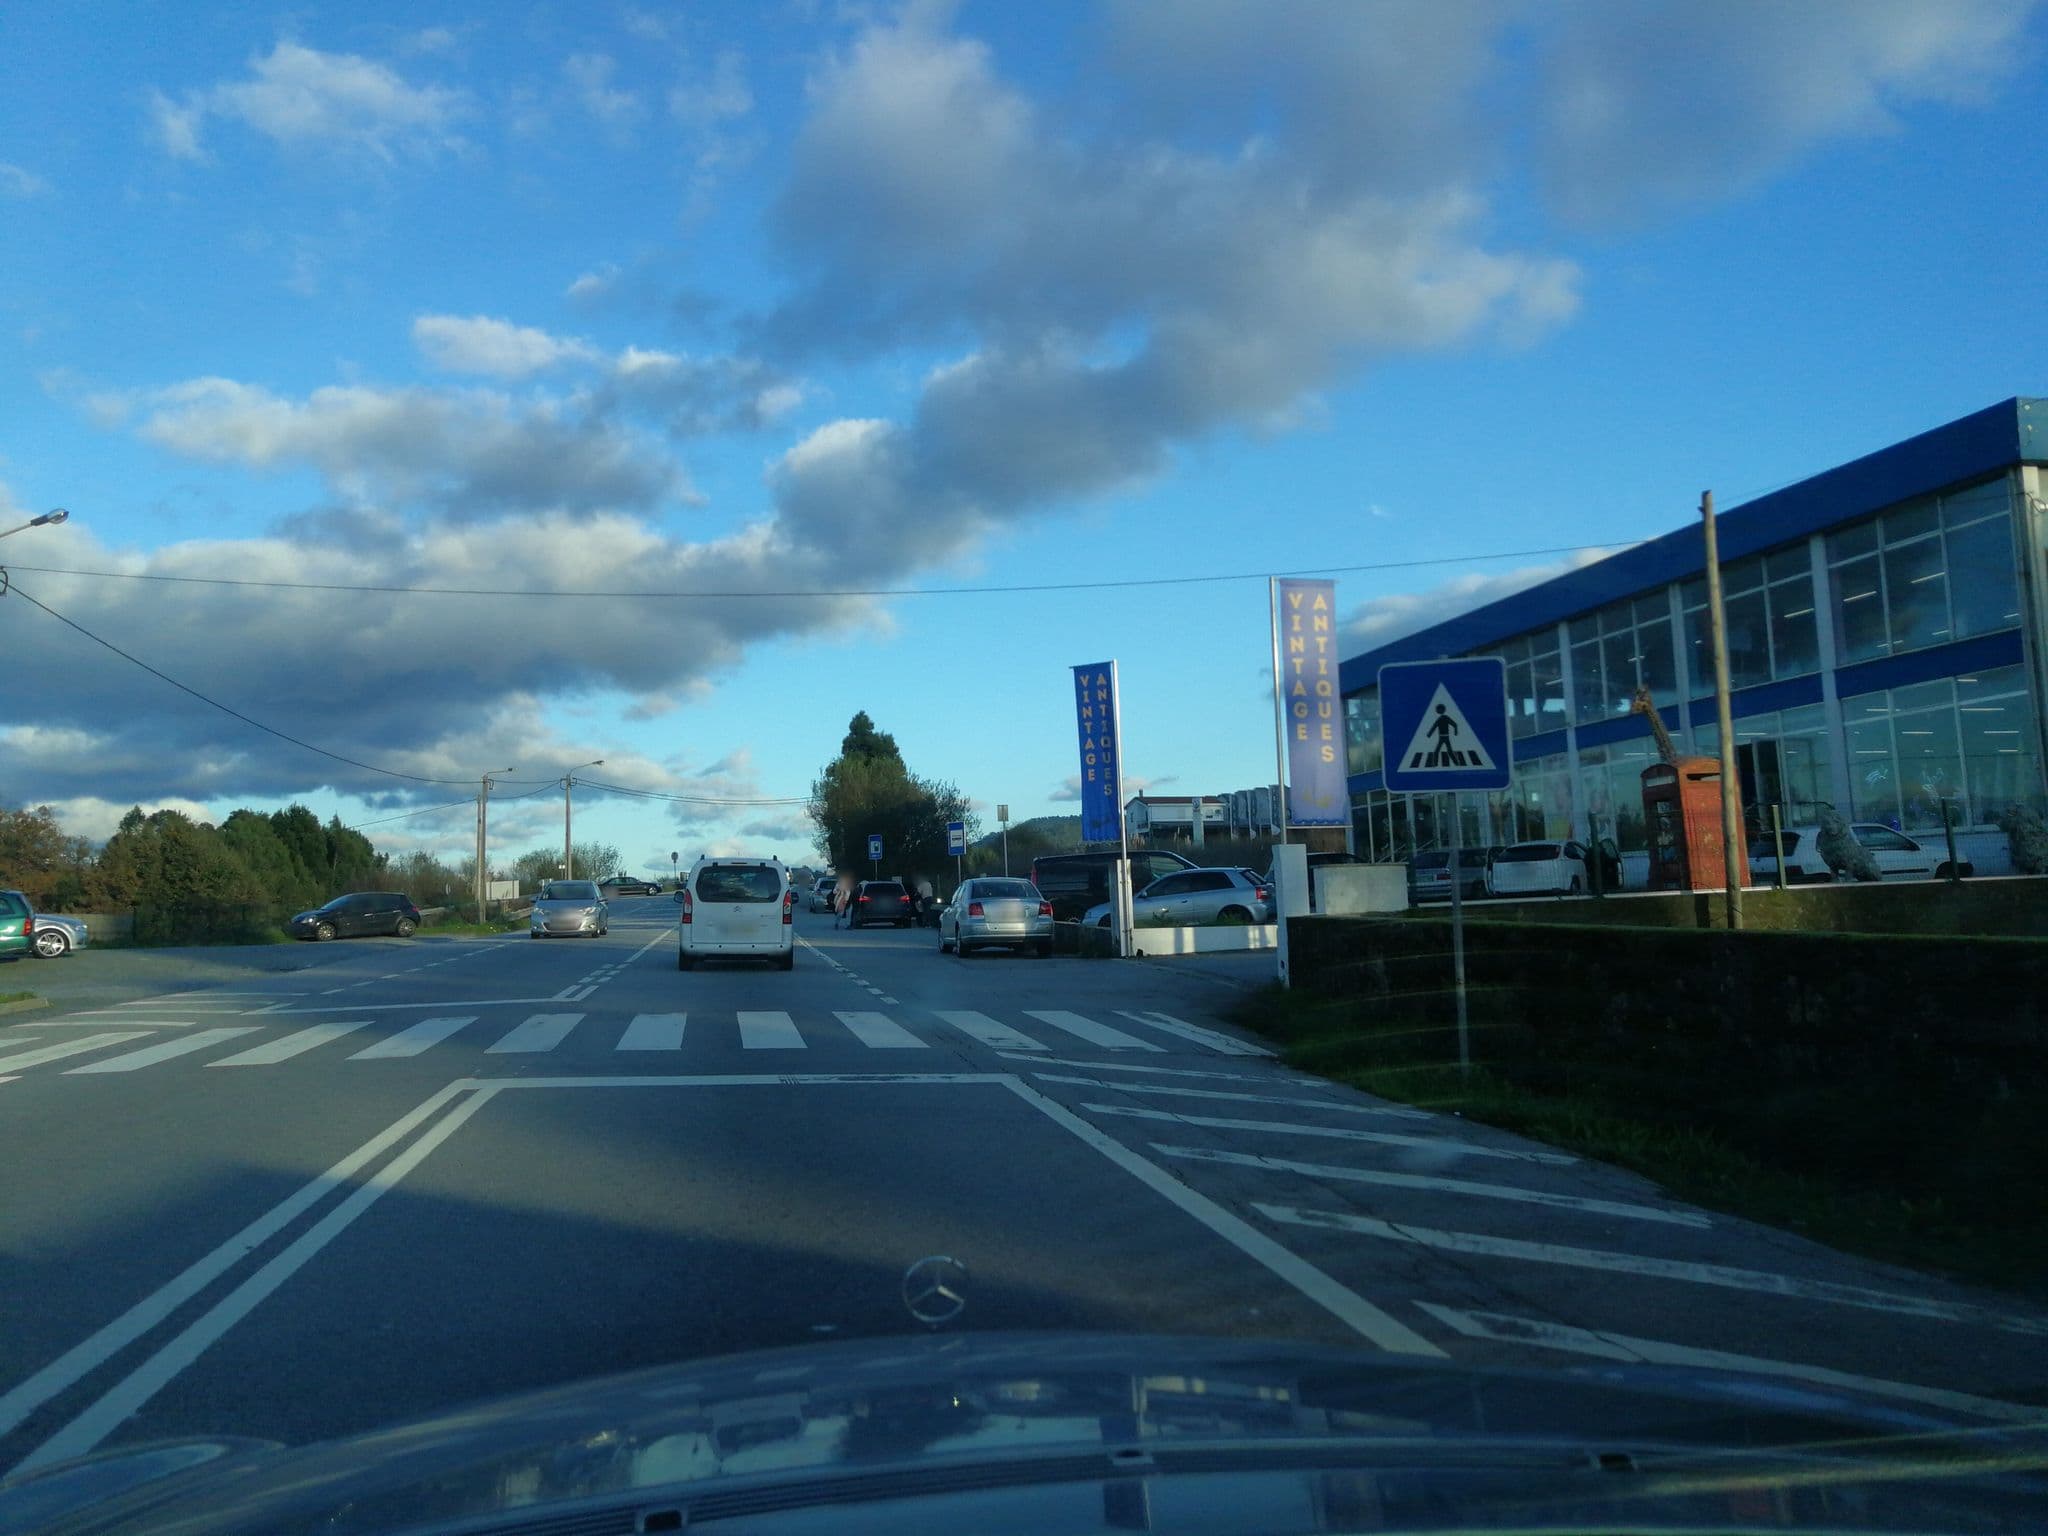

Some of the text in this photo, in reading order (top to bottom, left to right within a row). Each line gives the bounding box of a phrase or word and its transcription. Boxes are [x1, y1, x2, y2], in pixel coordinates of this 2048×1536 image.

[1081, 675, 1096, 782] VINTAGE
[1289, 593, 1308, 740] VINTAGE
[1313, 593, 1335, 763] ANTIQUES
[1097, 673, 1112, 796] ANTIQUES
